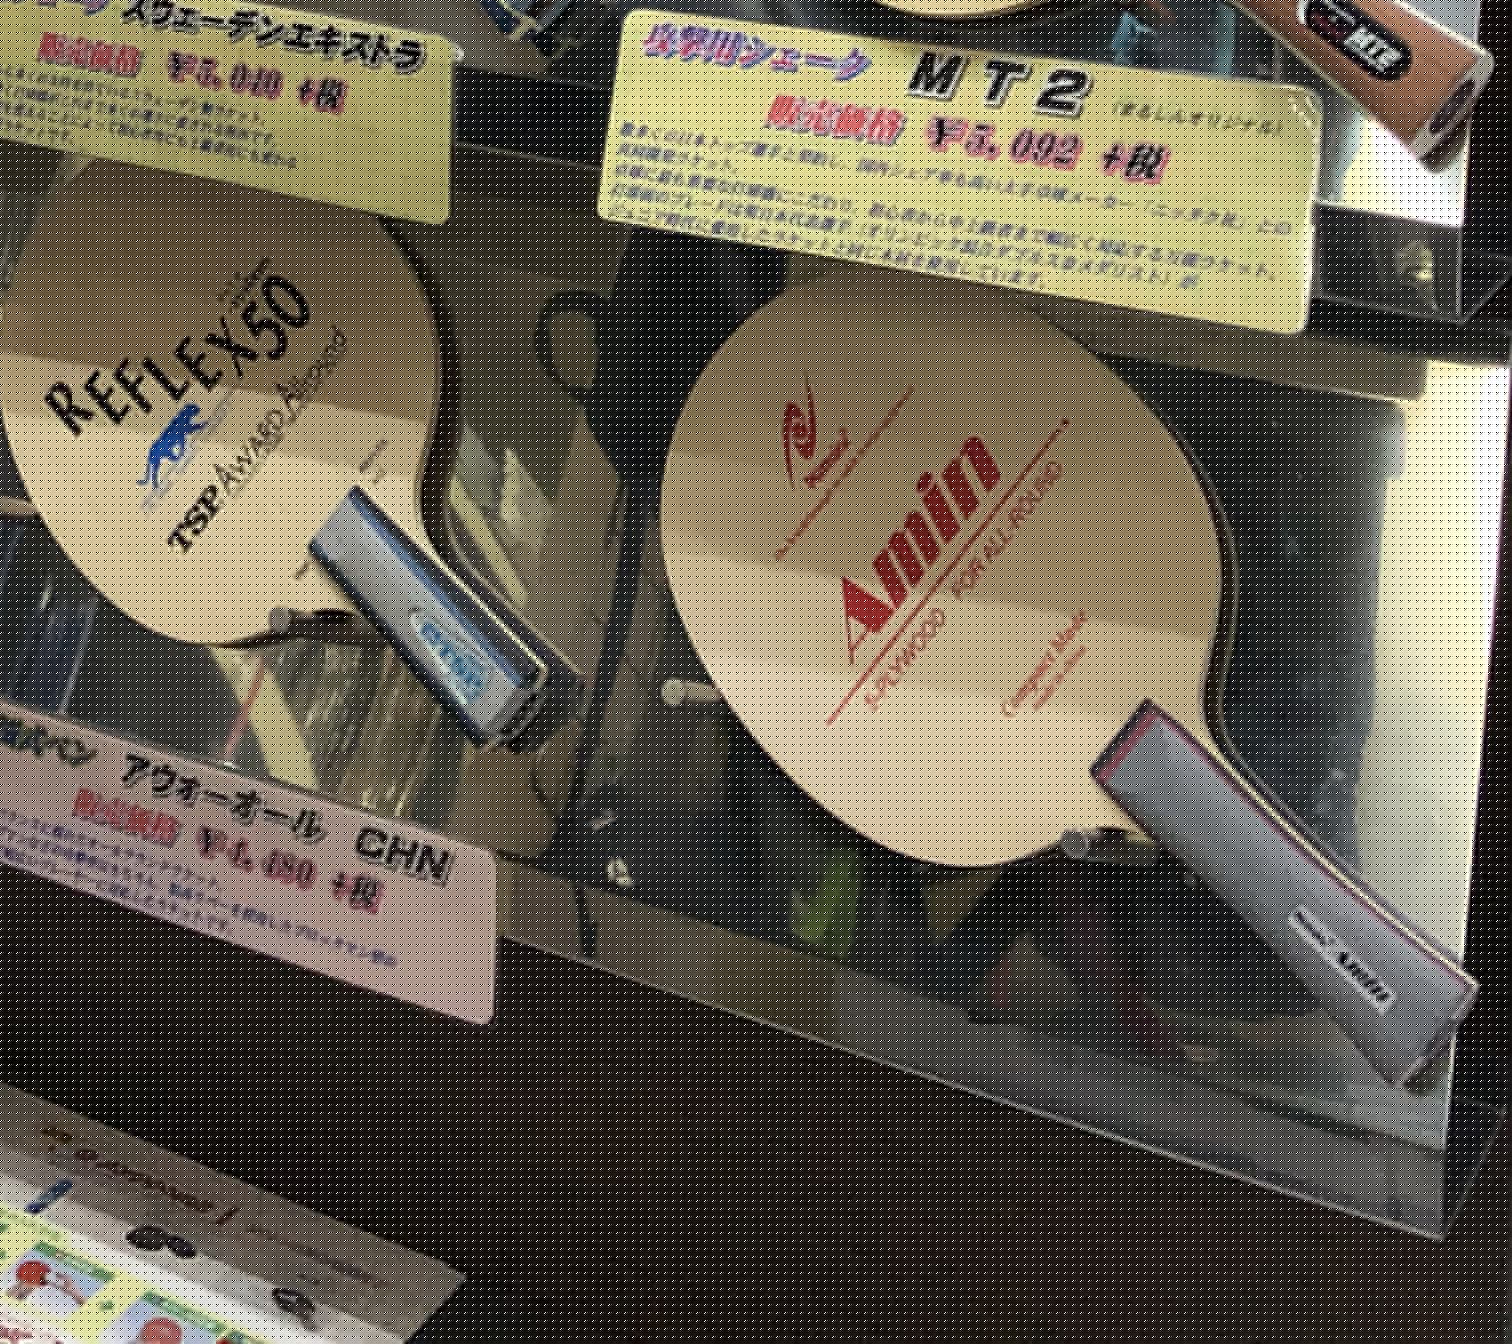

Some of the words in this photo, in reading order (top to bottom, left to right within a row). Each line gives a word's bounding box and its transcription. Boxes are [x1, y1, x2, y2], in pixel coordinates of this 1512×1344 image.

[165, 485, 221, 555] TSP
[841, 433, 1003, 667] Amin
[119, 751, 330, 845] アウォーオール
[353, 824, 457, 890] CHN
